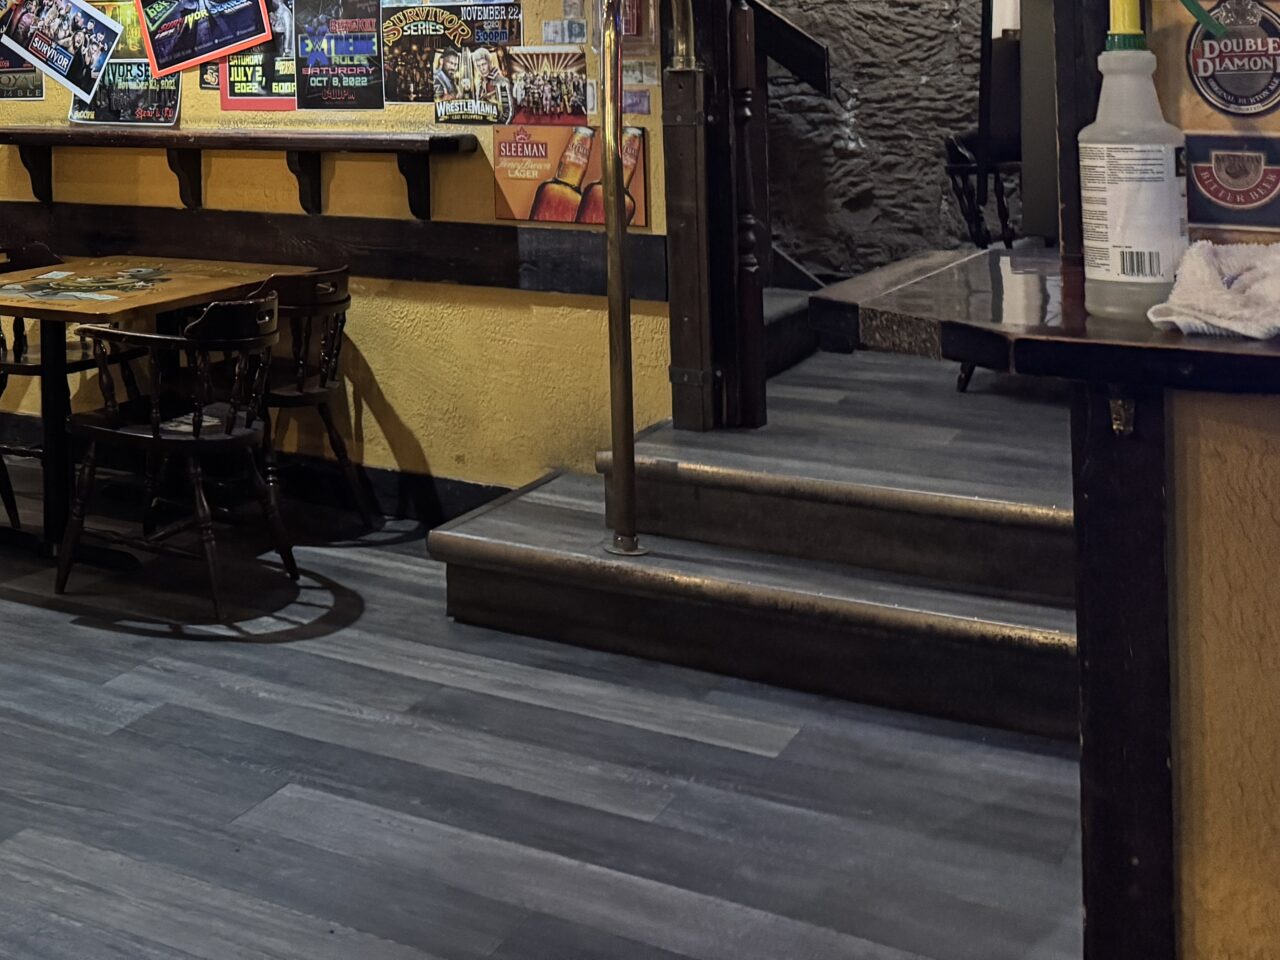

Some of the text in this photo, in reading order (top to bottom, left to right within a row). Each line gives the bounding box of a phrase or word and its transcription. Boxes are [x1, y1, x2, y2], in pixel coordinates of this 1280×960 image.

[461, 6, 522, 22] NOVEMBER 22,
[383, 7, 471, 47] SURVIVOR
[403, 21, 445, 36] SERIES
[483, 20, 499, 28] 2020
[32, 37, 70, 70] SURVIVOR
[1203, 37, 1280, 58] DOUBLE
[229, 55, 264, 66] SATURDAY
[331, 55, 369, 65] RULES
[230, 66, 253, 81] JULY
[302, 67, 375, 75] SATURDAY
[234, 82, 258, 93] 2022
[310, 77, 328, 87] OCT
[342, 76, 368, 86] 2022
[500, 143, 547, 157] SLEEMAN
[508, 169, 538, 178] LAGER
[1199, 170, 1279, 203] BITTER BEER
